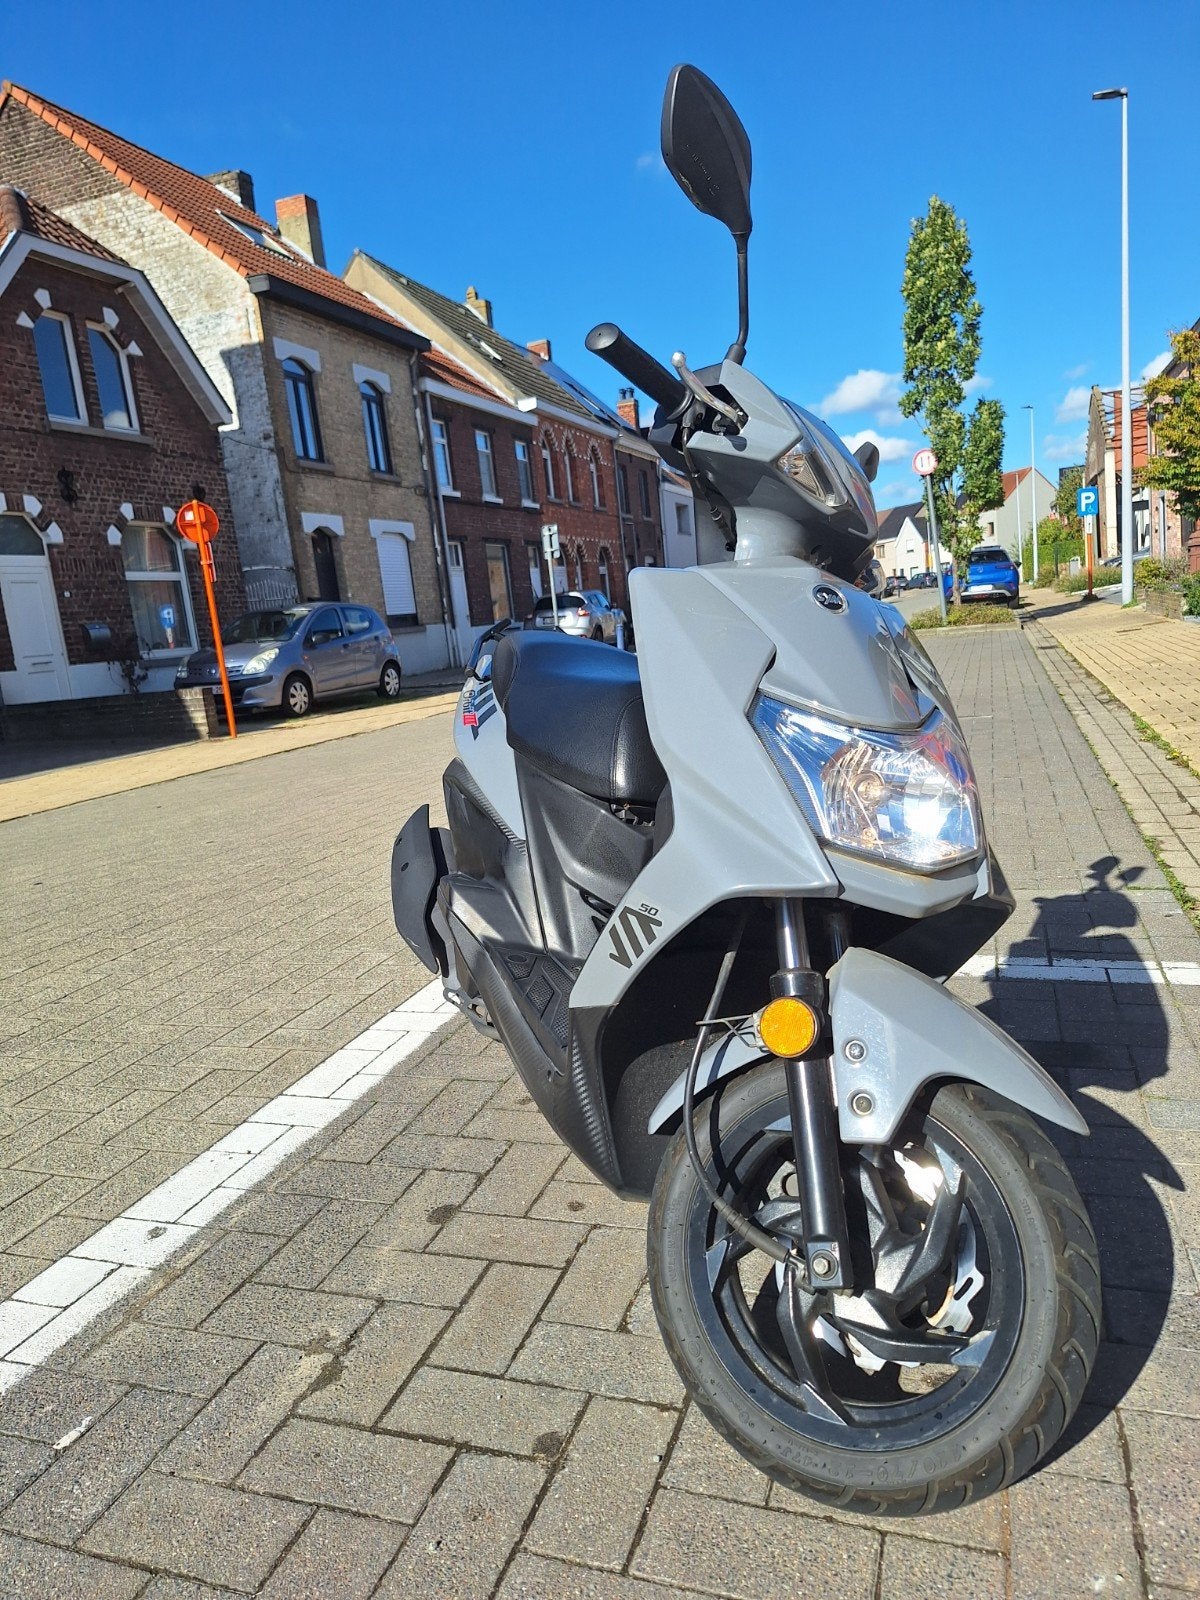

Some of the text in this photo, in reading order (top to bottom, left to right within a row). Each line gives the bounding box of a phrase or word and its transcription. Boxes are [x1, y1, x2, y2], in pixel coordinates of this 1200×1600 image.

[1081, 491, 1095, 512] P
[463, 690, 476, 714] Orbit
[638, 903, 659, 916] 50
